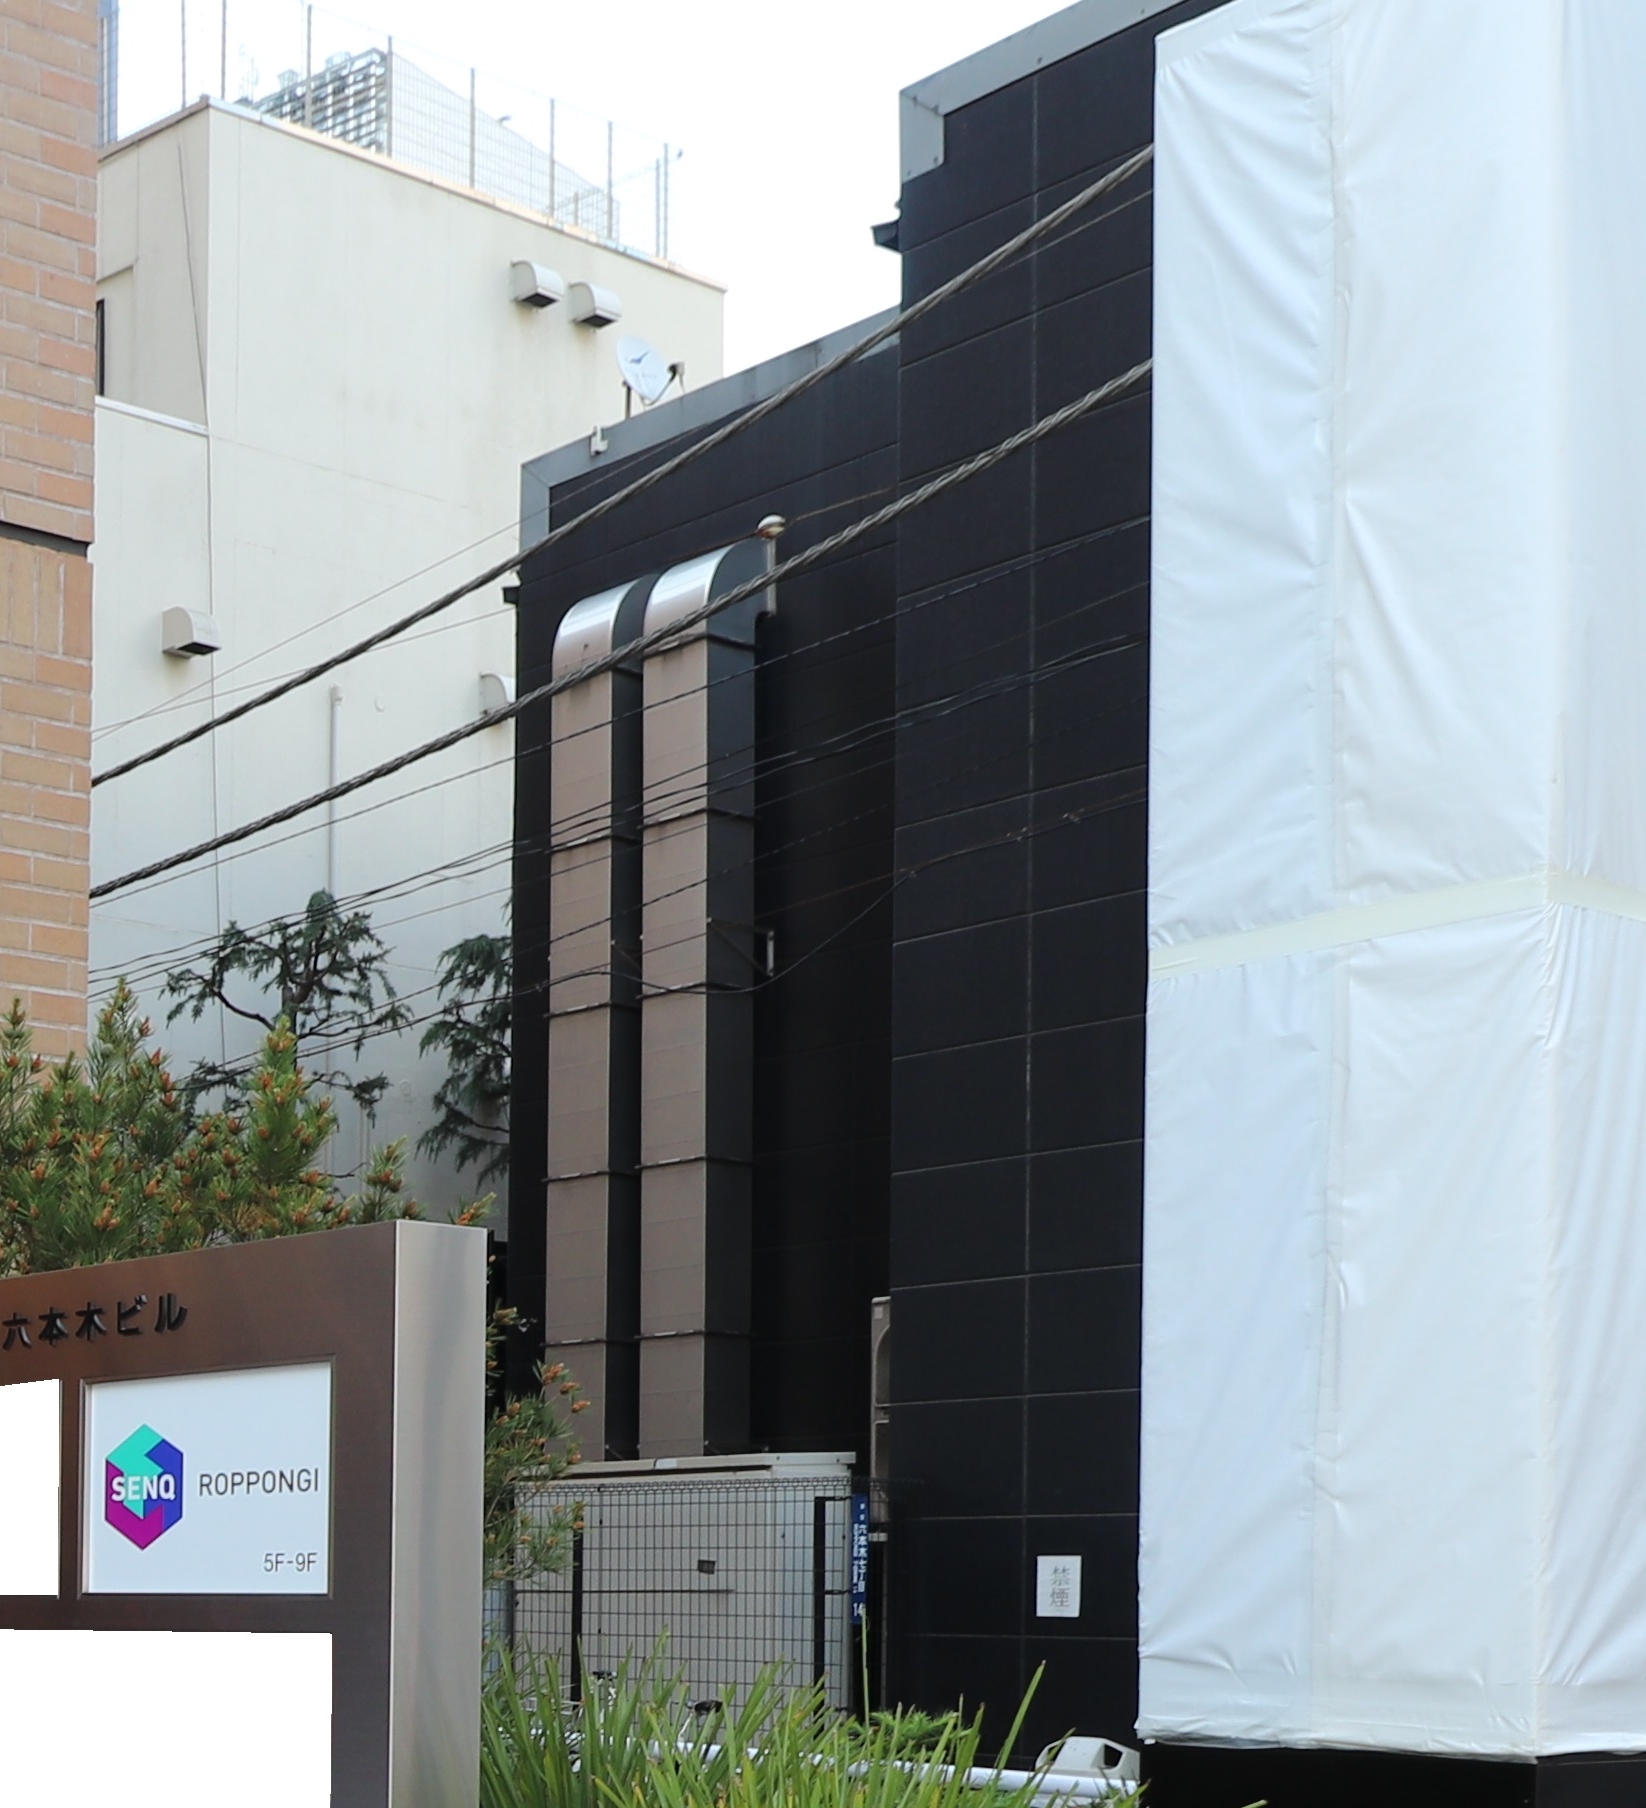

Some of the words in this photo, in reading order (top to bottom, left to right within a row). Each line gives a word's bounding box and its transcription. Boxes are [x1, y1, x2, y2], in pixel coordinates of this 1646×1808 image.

[111, 1473, 176, 1501] SENQ
[198, 1468, 319, 1497] ROPPONGI
[263, 1552, 318, 1573] 5F-9F
[1049, 1565, 1071, 1608] 禁煙
